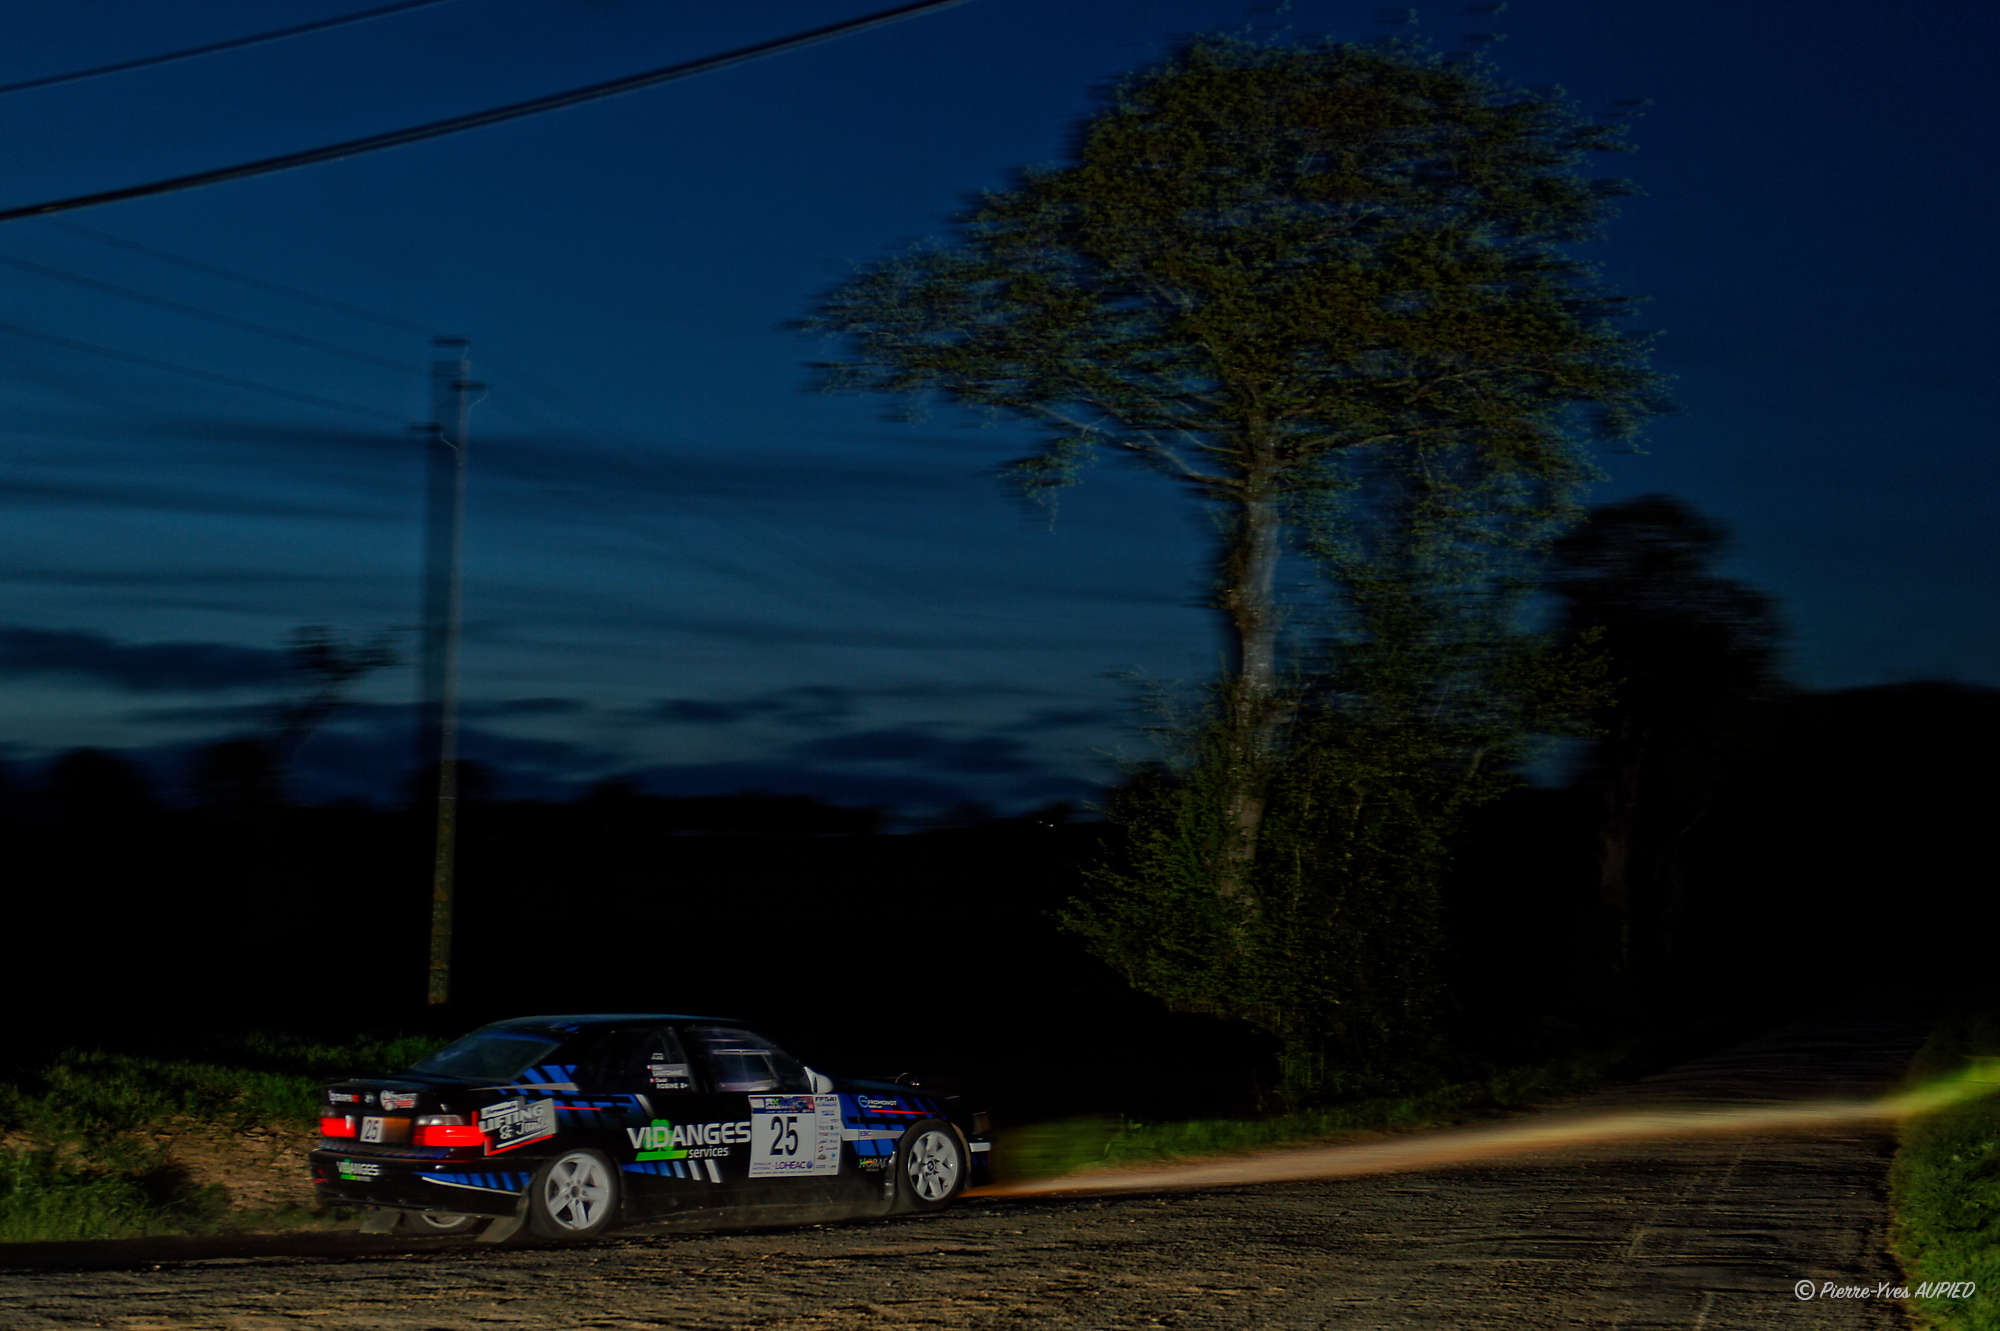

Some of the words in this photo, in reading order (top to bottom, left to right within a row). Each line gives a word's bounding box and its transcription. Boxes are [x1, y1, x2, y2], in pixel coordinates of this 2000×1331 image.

[365, 1119, 379, 1140] 25
[478, 1104, 545, 1133] LIFTING
[626, 1121, 751, 1149] VIDANGES
[769, 1116, 798, 1155] 25
[688, 1146, 728, 1158] services
